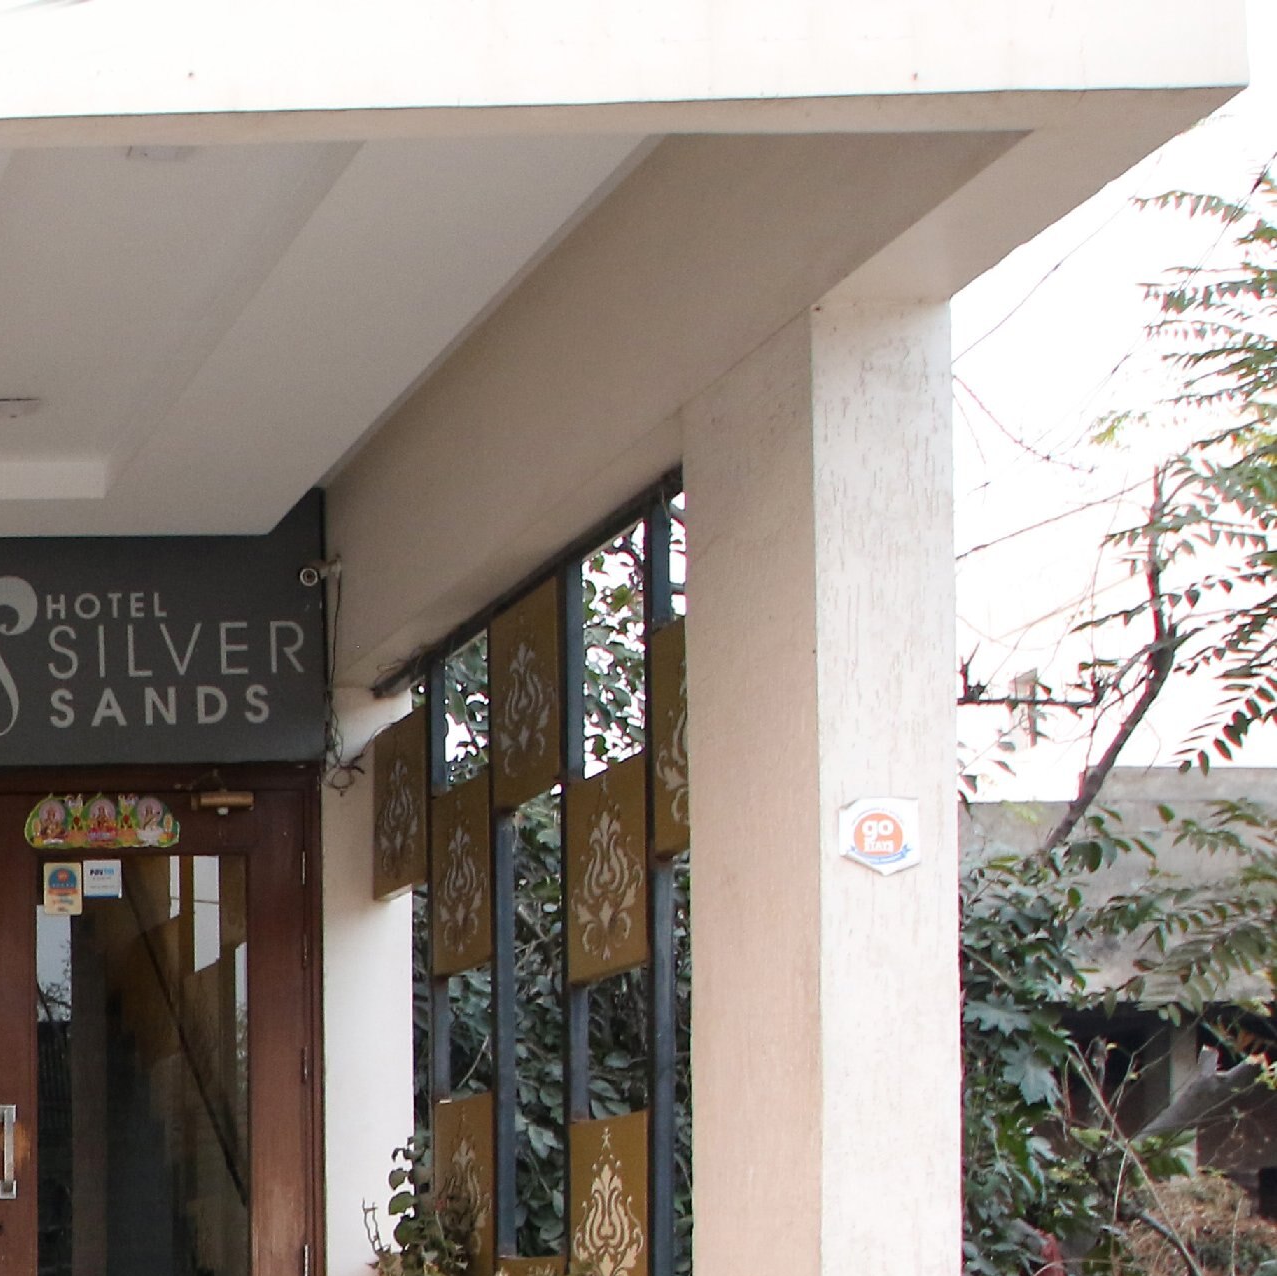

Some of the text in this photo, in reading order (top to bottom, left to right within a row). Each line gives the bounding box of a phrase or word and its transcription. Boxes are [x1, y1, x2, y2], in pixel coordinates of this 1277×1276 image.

[46, 592, 168, 620] HOTEL
[48, 620, 305, 680] SILVER
[49, 684, 270, 728] SANDS
[861, 819, 894, 842] go
